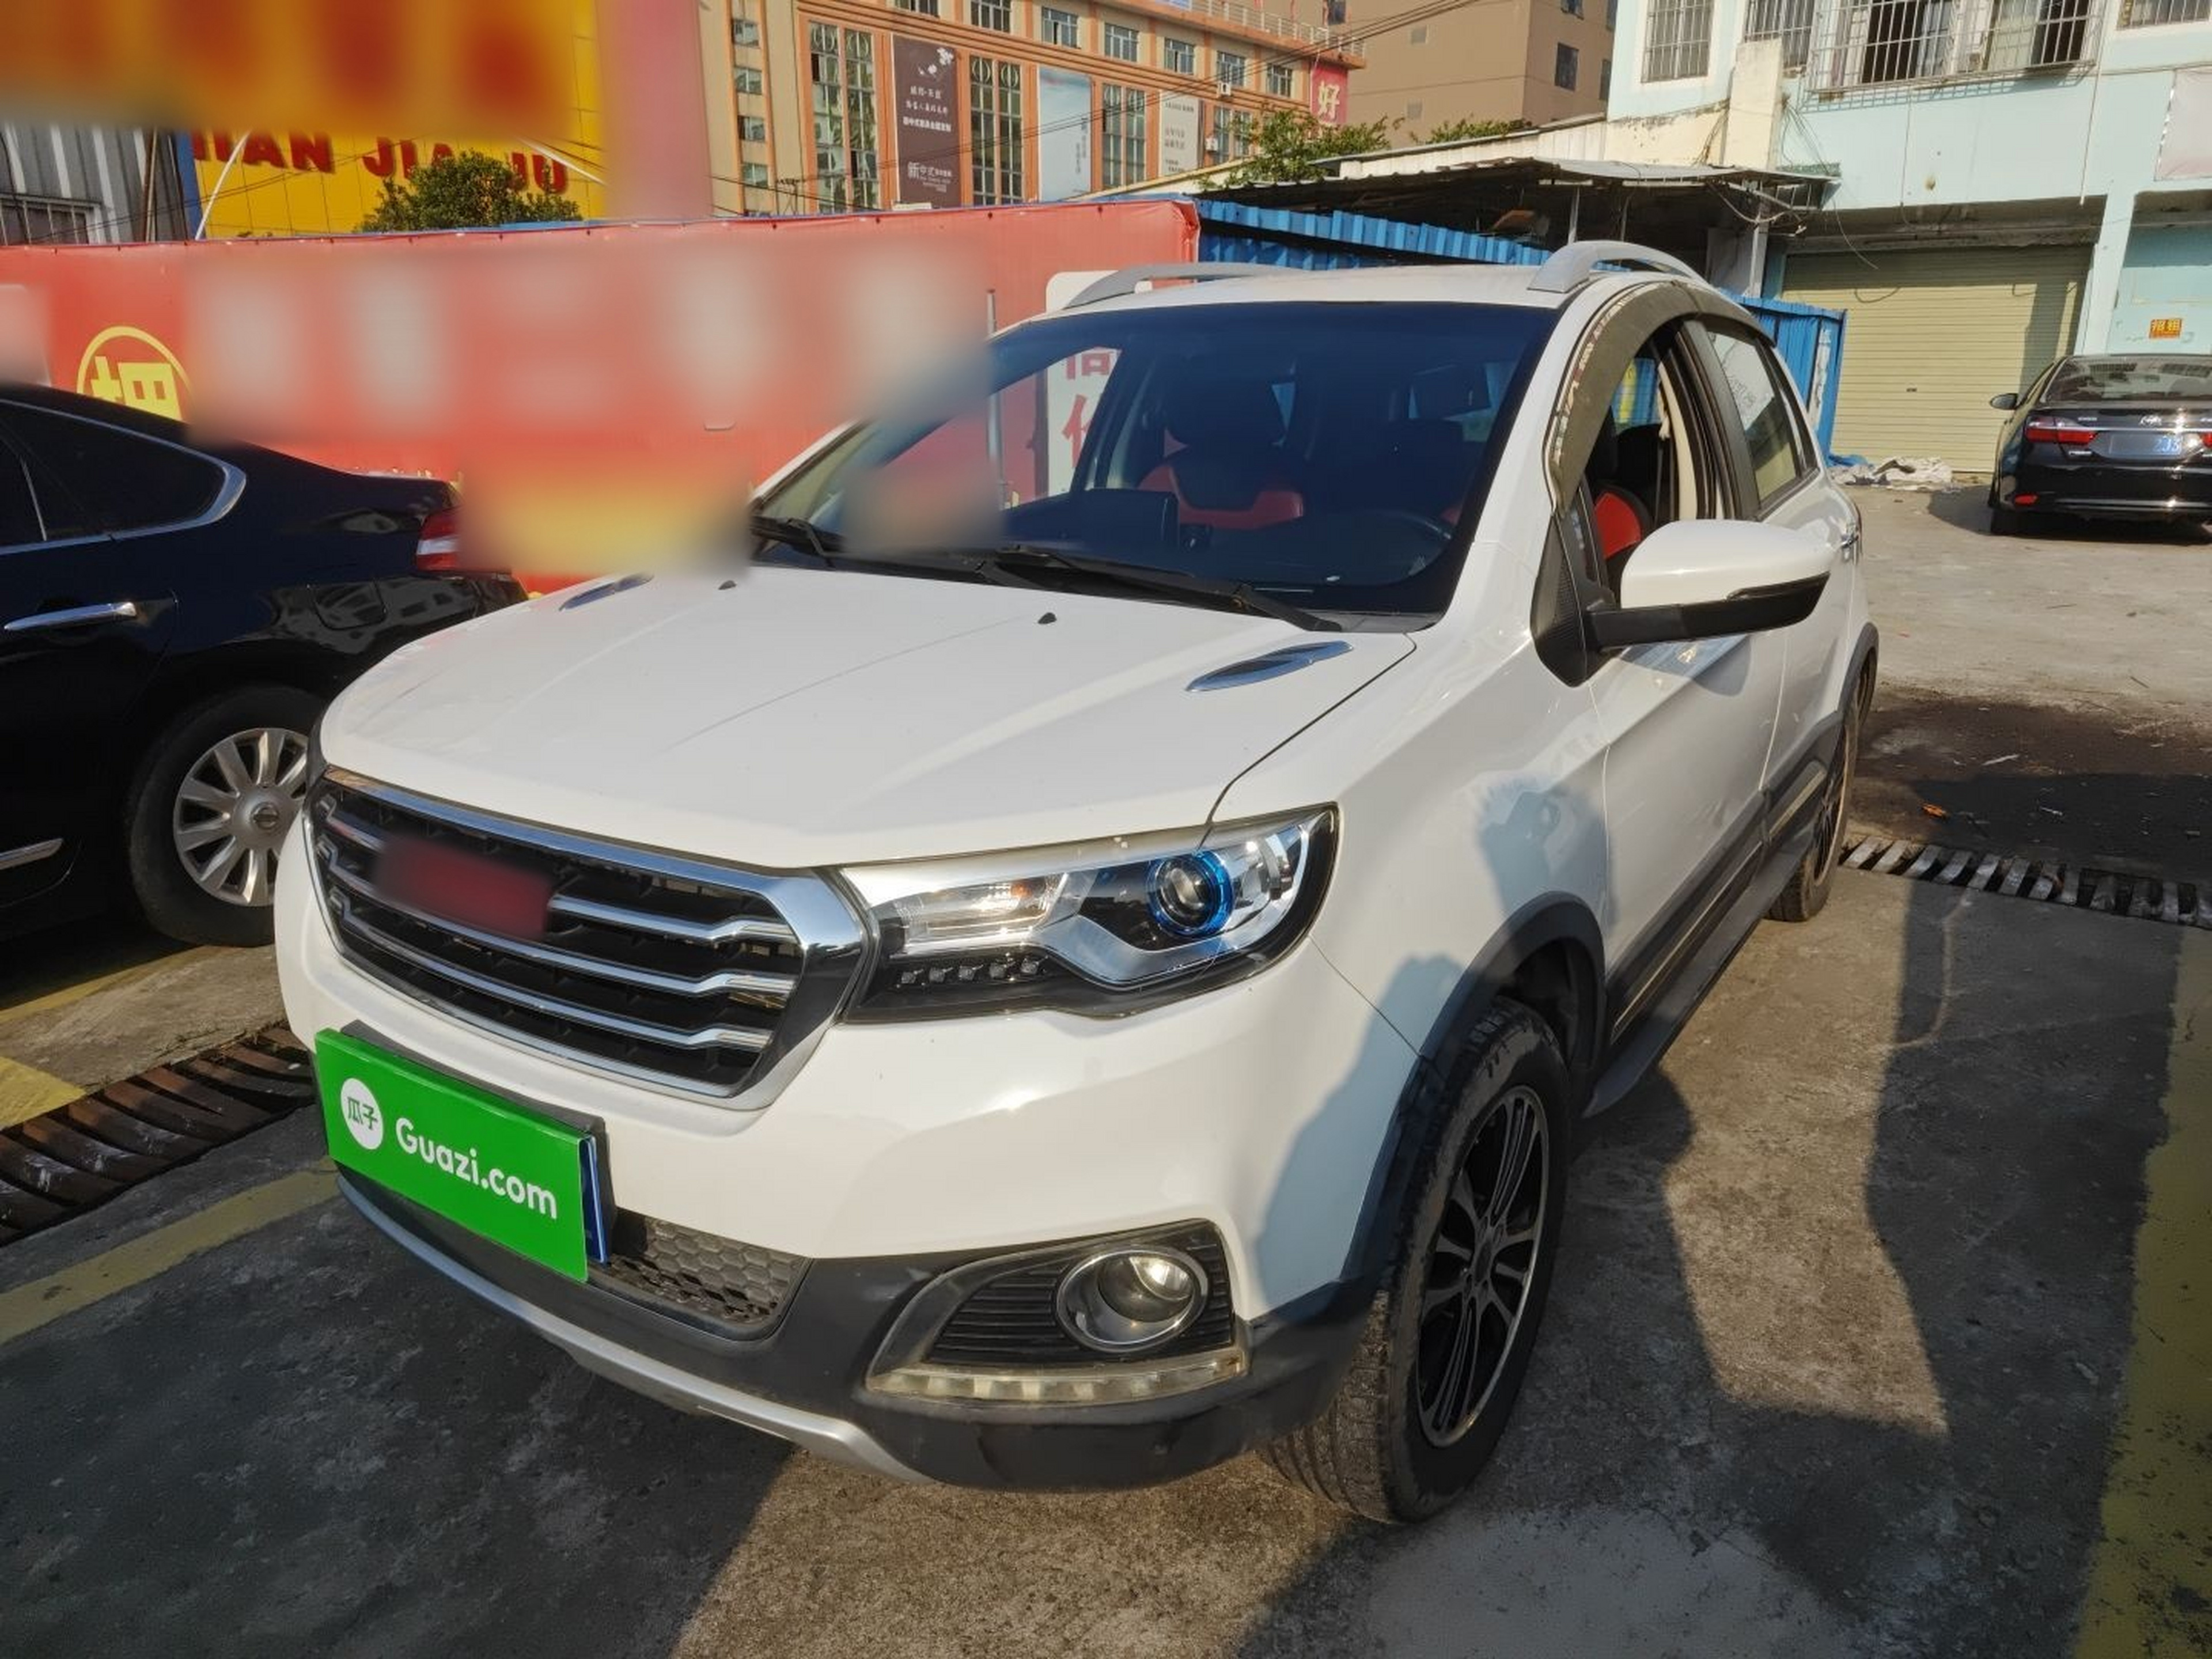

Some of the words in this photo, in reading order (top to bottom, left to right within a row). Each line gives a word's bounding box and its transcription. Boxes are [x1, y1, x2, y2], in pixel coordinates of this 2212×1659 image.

[1318, 81, 1340, 119] 好
[347, 1096, 378, 1130] 瓜子
[396, 1118, 557, 1219] Guazi.com
